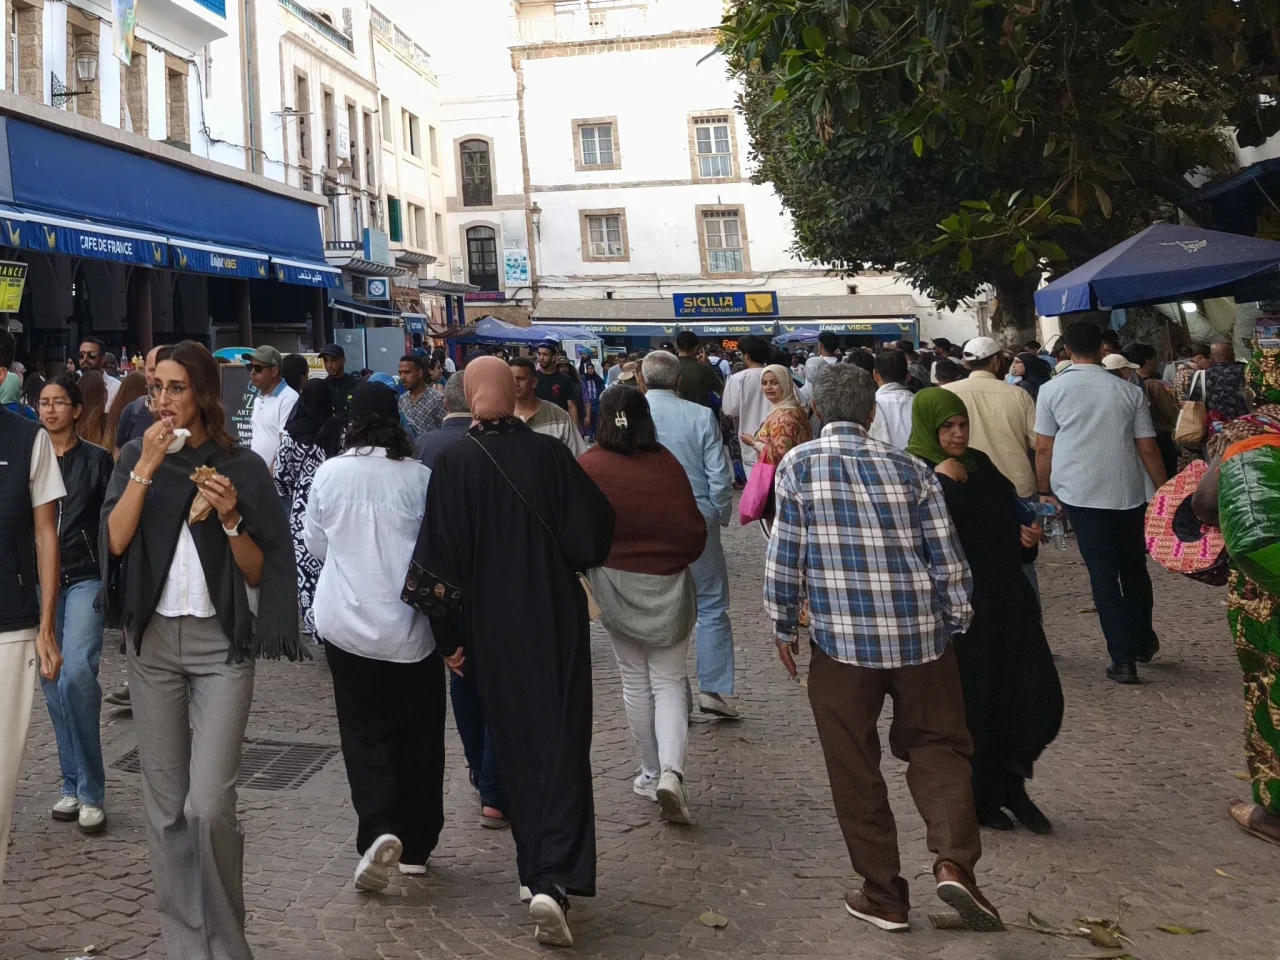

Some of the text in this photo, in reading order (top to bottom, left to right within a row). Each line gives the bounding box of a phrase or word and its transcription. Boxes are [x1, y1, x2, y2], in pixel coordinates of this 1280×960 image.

[80, 236, 132, 255] CAFE DE FRANCE
[684, 297, 733, 307] SICILIA
[704, 326, 727, 334] Unique
[819, 324, 845, 332] Unique
